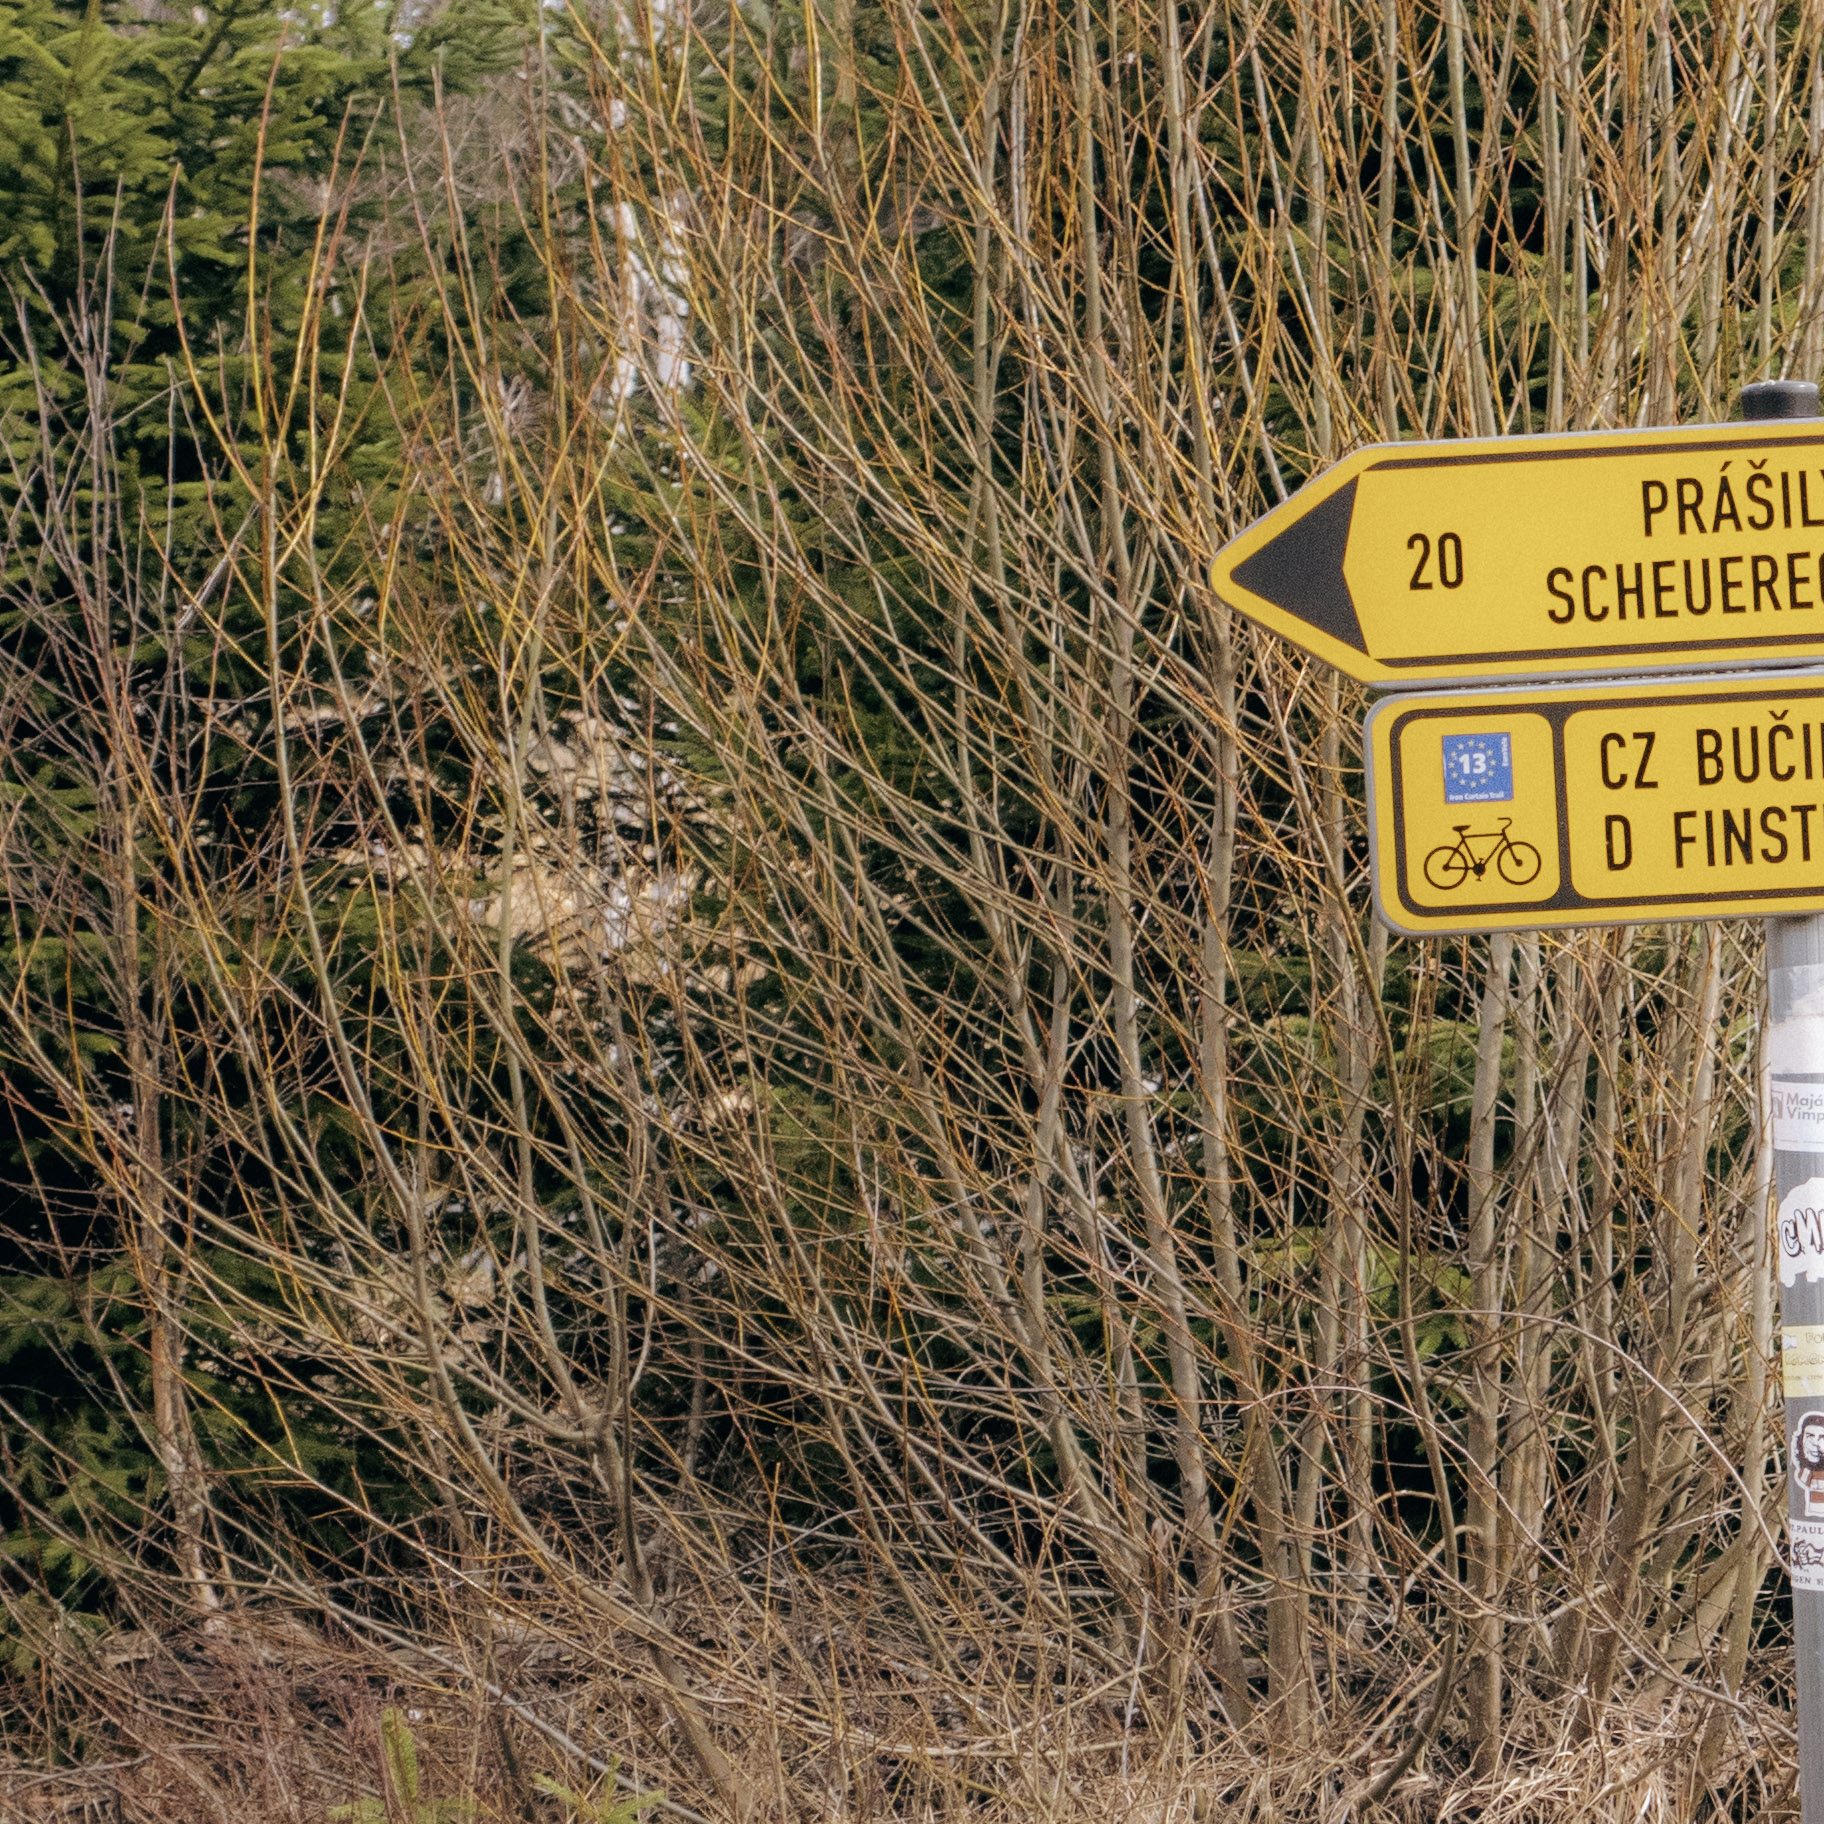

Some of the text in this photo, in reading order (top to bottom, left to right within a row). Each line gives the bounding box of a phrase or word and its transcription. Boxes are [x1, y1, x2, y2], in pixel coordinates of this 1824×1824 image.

[1407, 532, 1464, 590] 20
[1458, 753, 1486, 775] 13
[1599, 731, 1659, 790] CZ
[1604, 814, 1632, 871] D
